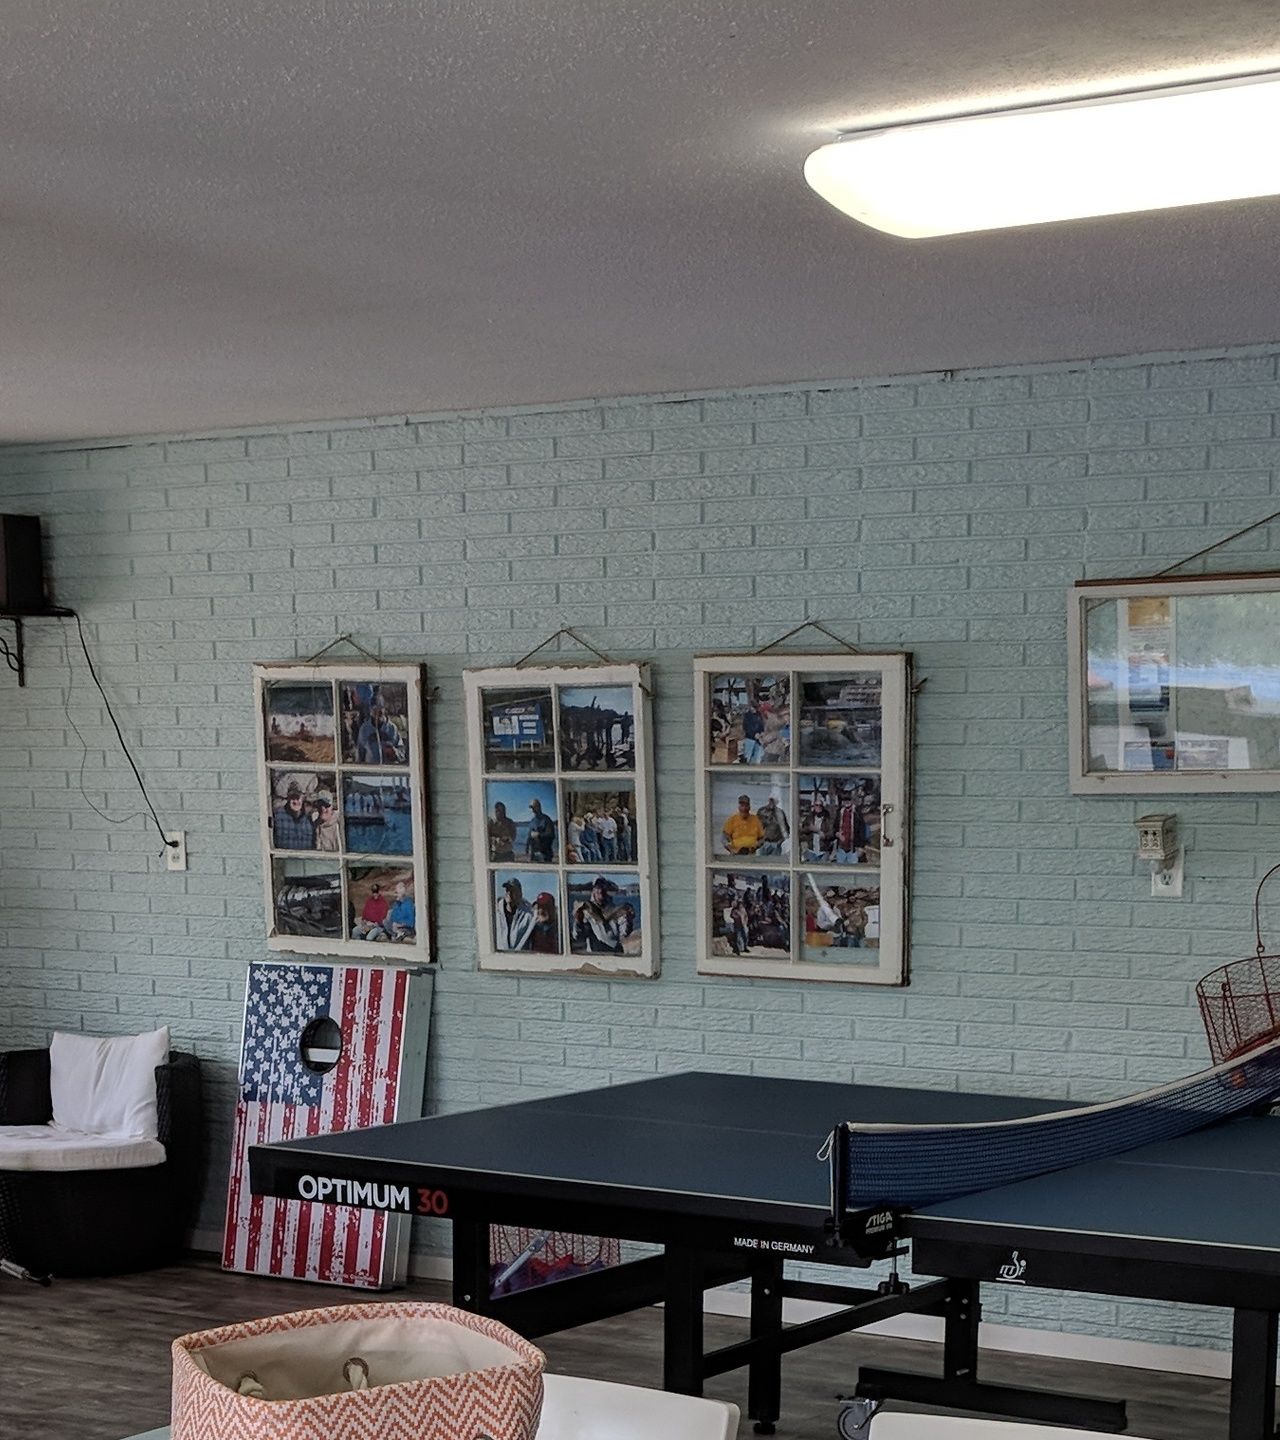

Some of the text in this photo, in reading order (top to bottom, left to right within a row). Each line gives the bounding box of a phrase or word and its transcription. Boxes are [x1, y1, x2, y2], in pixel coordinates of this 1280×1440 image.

[297, 1174, 448, 1214] OPTIMUM 30
[866, 1211, 893, 1228] STIGA
[733, 1236, 816, 1254] MADE IN GERMANY
